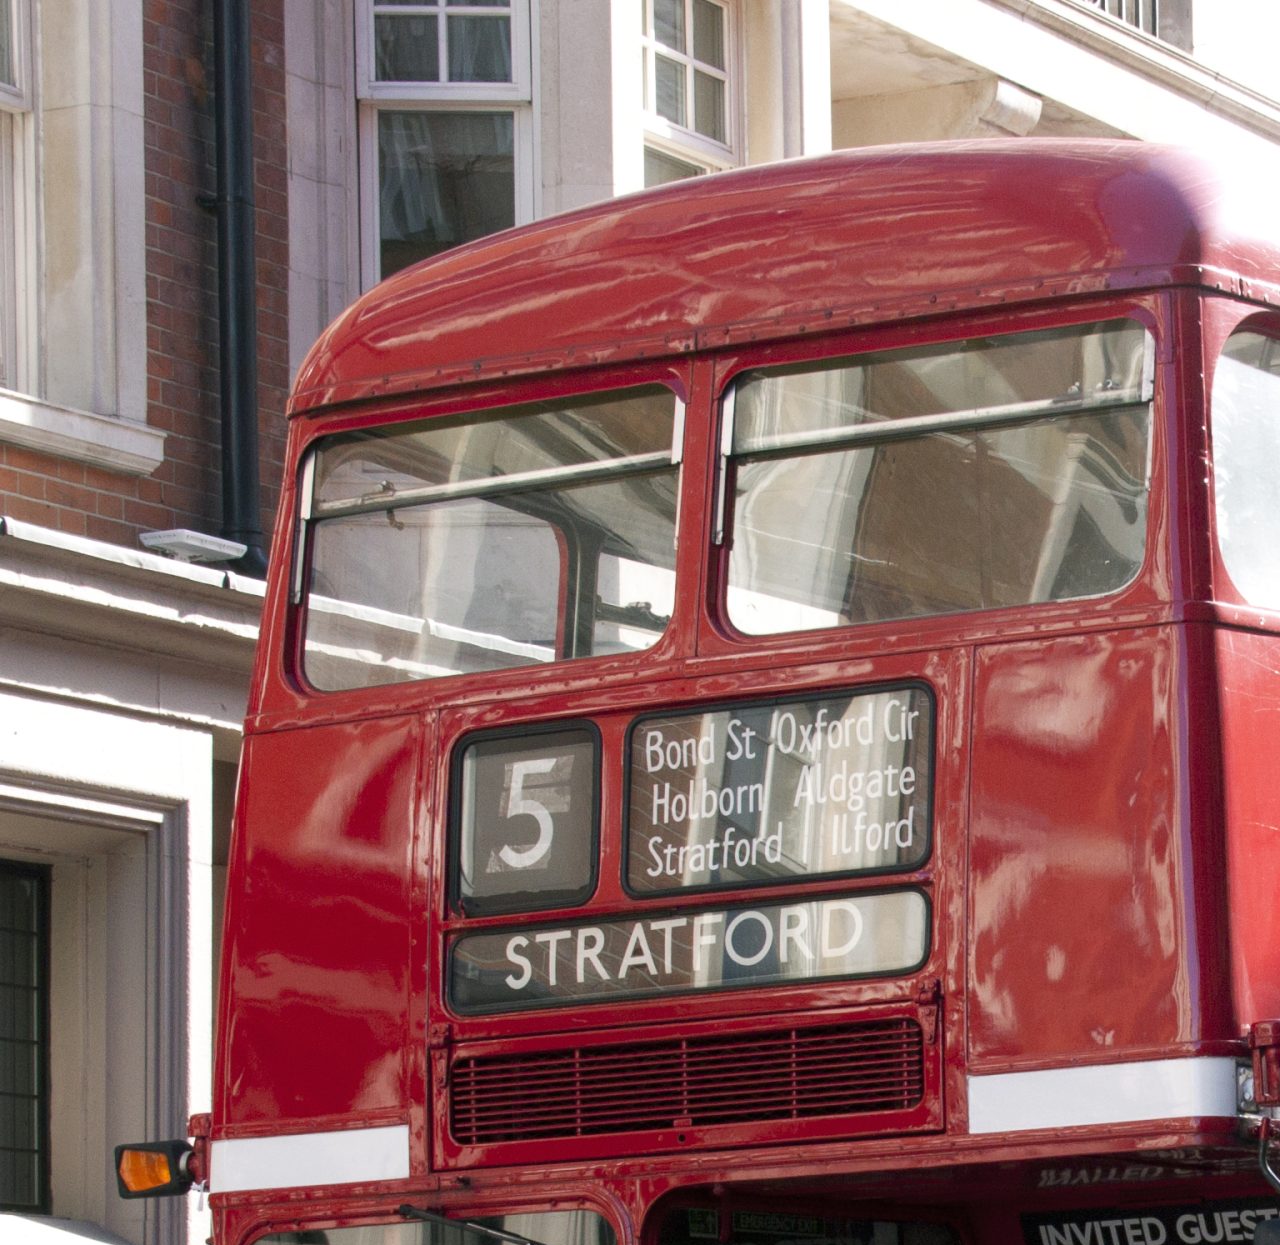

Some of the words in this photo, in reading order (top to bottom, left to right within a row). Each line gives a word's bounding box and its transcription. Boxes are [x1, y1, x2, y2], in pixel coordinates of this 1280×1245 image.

[646, 723, 715, 772] Bond
[726, 719, 757, 760] St
[777, 702, 874, 754] Oxford
[883, 699, 919, 743] Cir
[499, 758, 554, 868] 5
[652, 777, 764, 825] Holborn
[794, 760, 916, 812] Aldgate
[646, 821, 783, 877] Stratford
[831, 806, 914, 856] Ilford
[505, 901, 864, 990] STRATFORD
